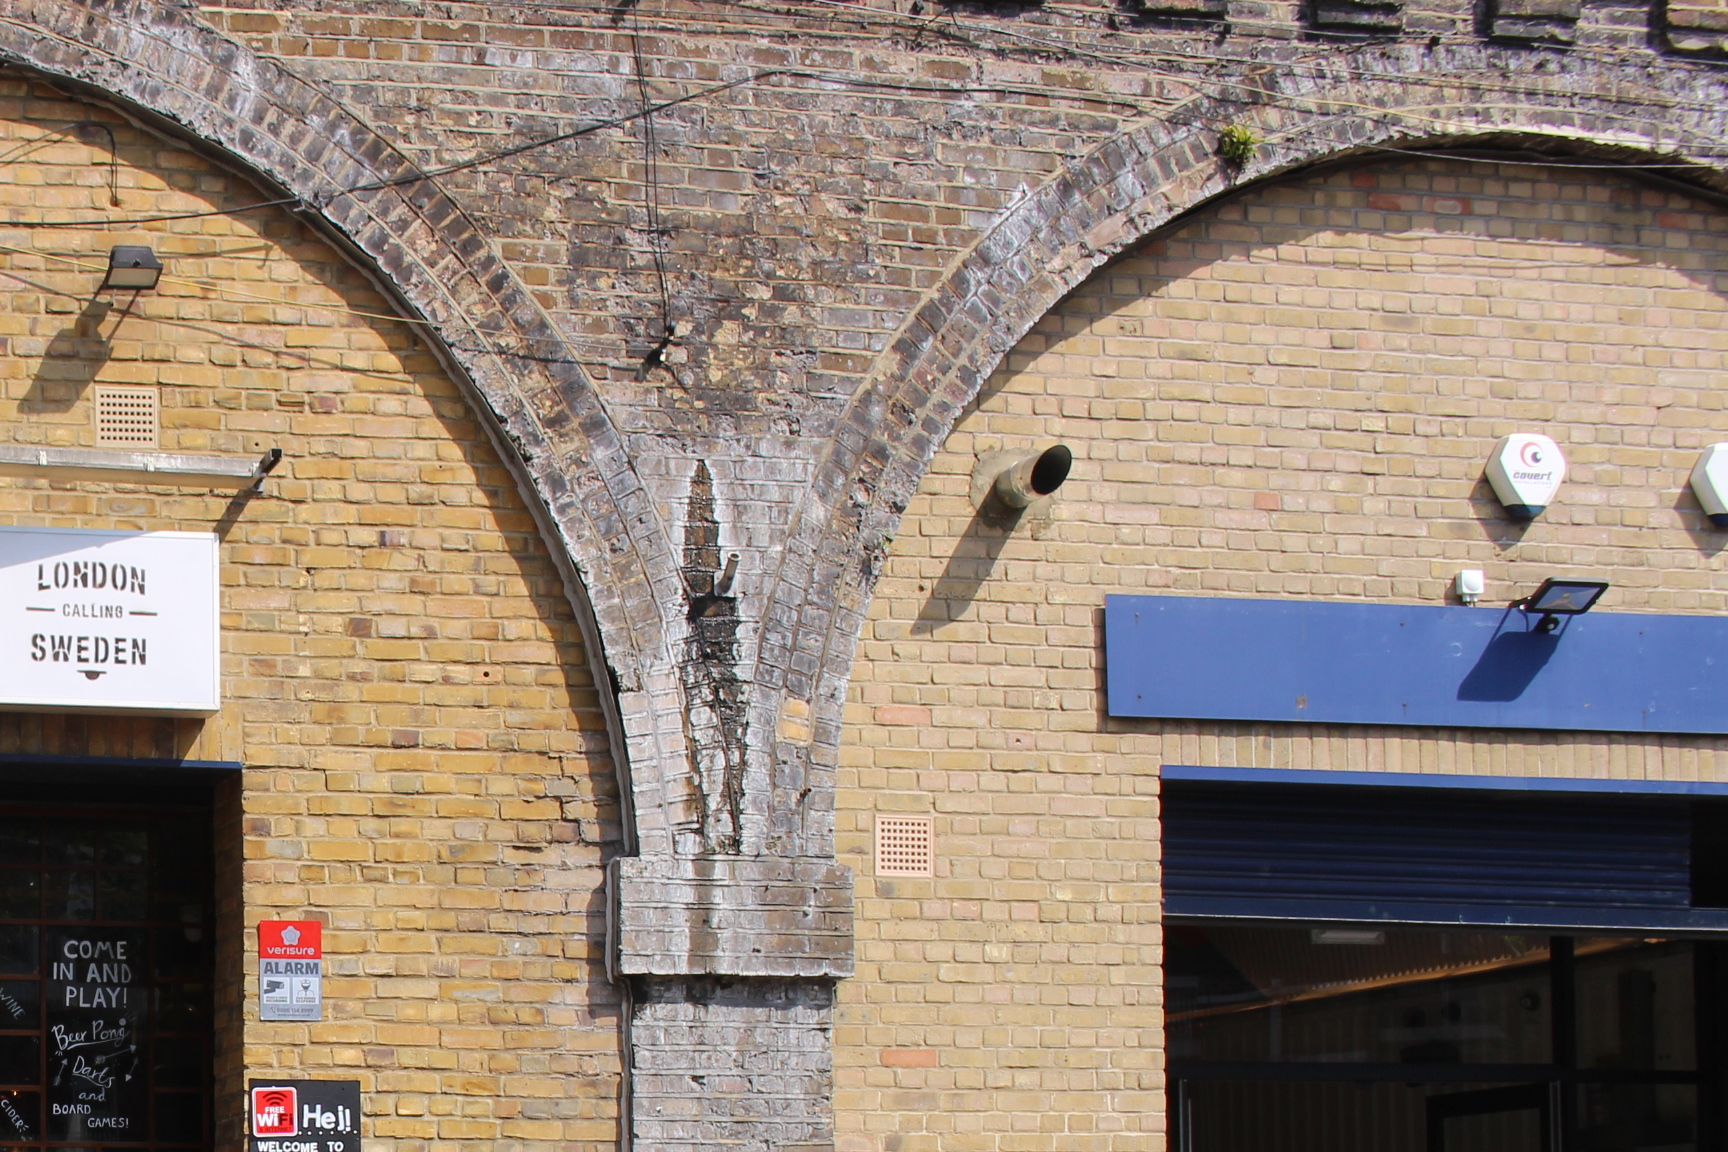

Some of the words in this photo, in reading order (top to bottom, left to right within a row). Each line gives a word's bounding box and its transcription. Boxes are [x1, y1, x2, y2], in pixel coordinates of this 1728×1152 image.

[1513, 471, 1552, 481] covert
[38, 561, 145, 596] LONDON
[62, 603, 123, 619] CALLING
[31, 633, 147, 665] SWEDEN
[63, 939, 127, 960] COME
[266, 946, 316, 955] verisure
[53, 962, 73, 980] IN
[86, 962, 132, 983] AND
[263, 961, 319, 975] ALARM
[65, 985, 127, 1009] PLAY!
[51, 1024, 87, 1050] Beer
[92, 1020, 129, 1047] Pong
[73, 1055, 115, 1088] Darts
[78, 1087, 107, 1102] and
[0, 1098, 24, 1133] CIDER
[52, 1103, 91, 1115] BOARD
[264, 1106, 285, 1114] FREE
[87, 1117, 129, 1129] GAMES!
[257, 1113, 294, 1127] WiFi
[302, 1104, 352, 1132] Hej!
[257, 1141, 319, 1152] WELCOME
[326, 1141, 344, 1152] TO
